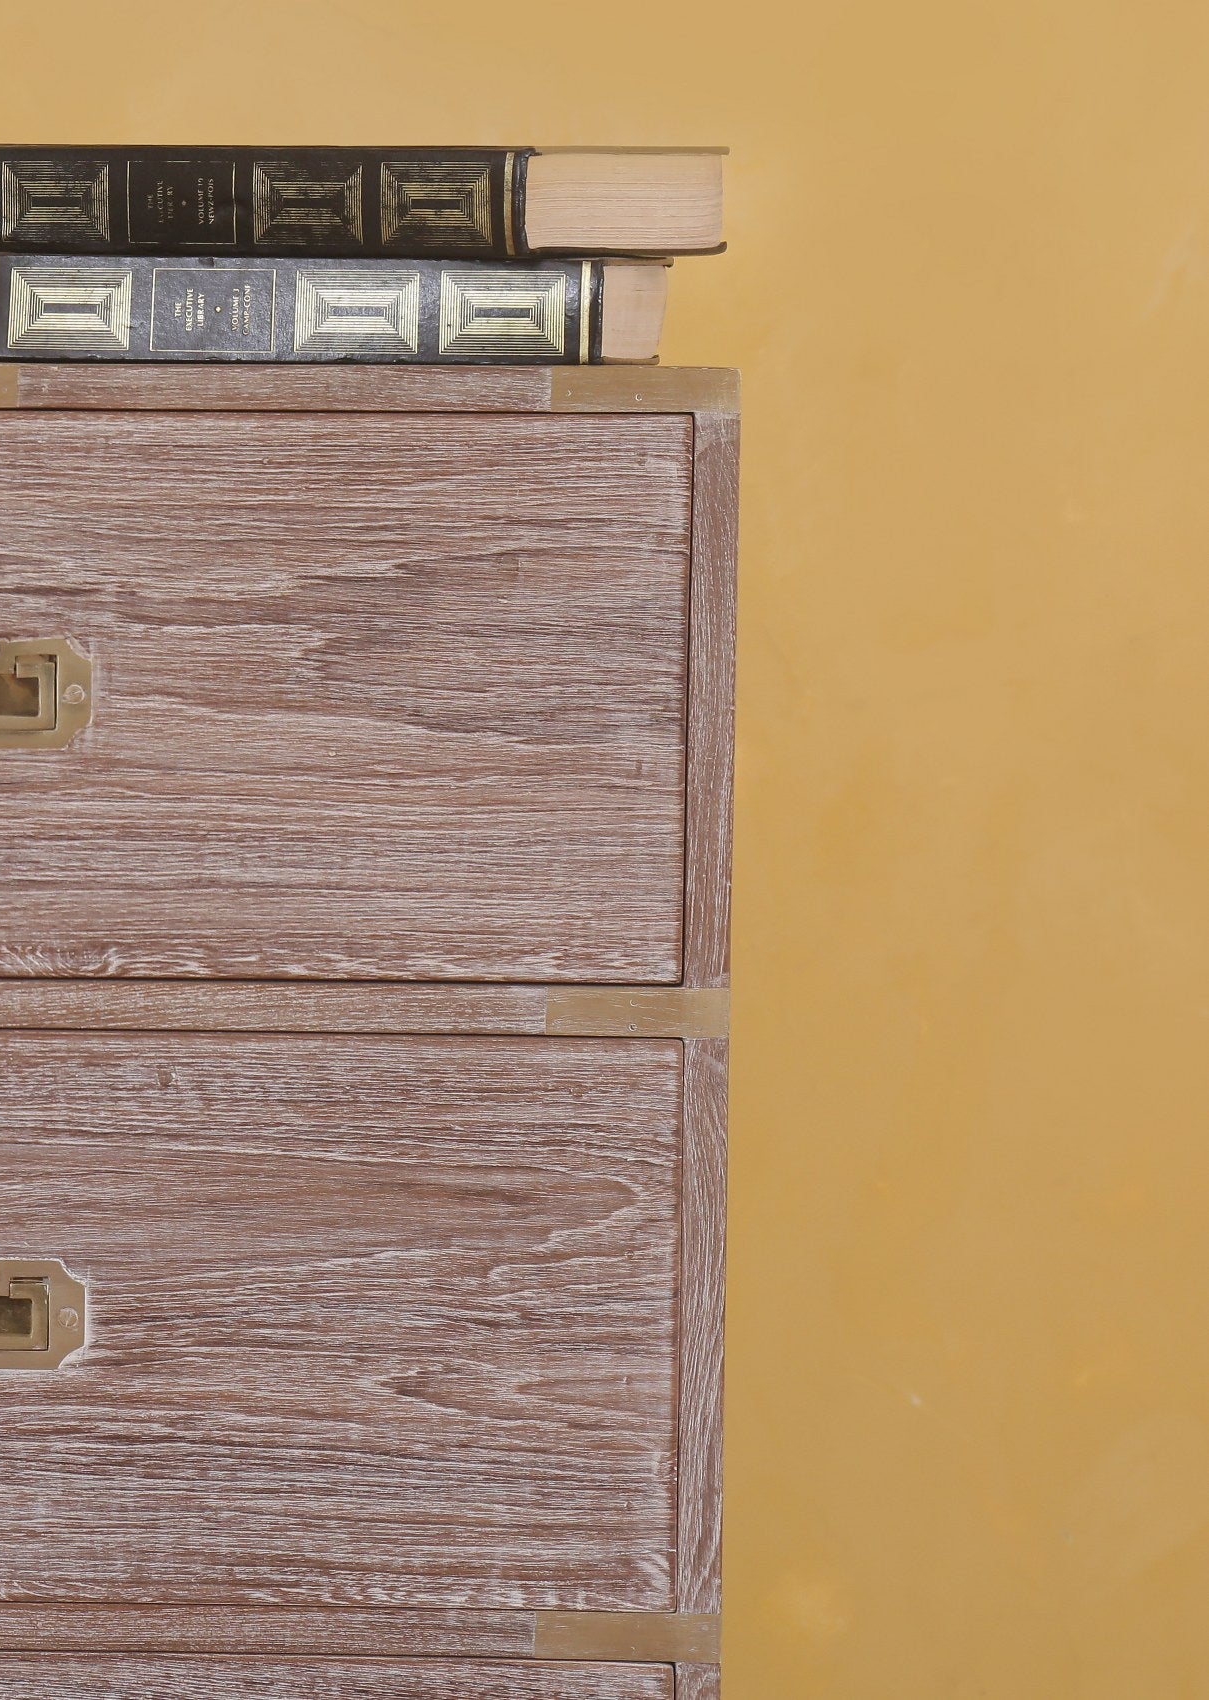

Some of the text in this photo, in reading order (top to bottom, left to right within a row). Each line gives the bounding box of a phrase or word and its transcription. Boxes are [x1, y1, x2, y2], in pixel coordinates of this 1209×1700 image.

[197, 189, 205, 225] VOLUME
[174, 301, 182, 317] THE
[185, 288, 194, 332] EXECUTIVE
[197, 292, 205, 327] LIBRARY
[231, 295, 240, 331] VOLUME
